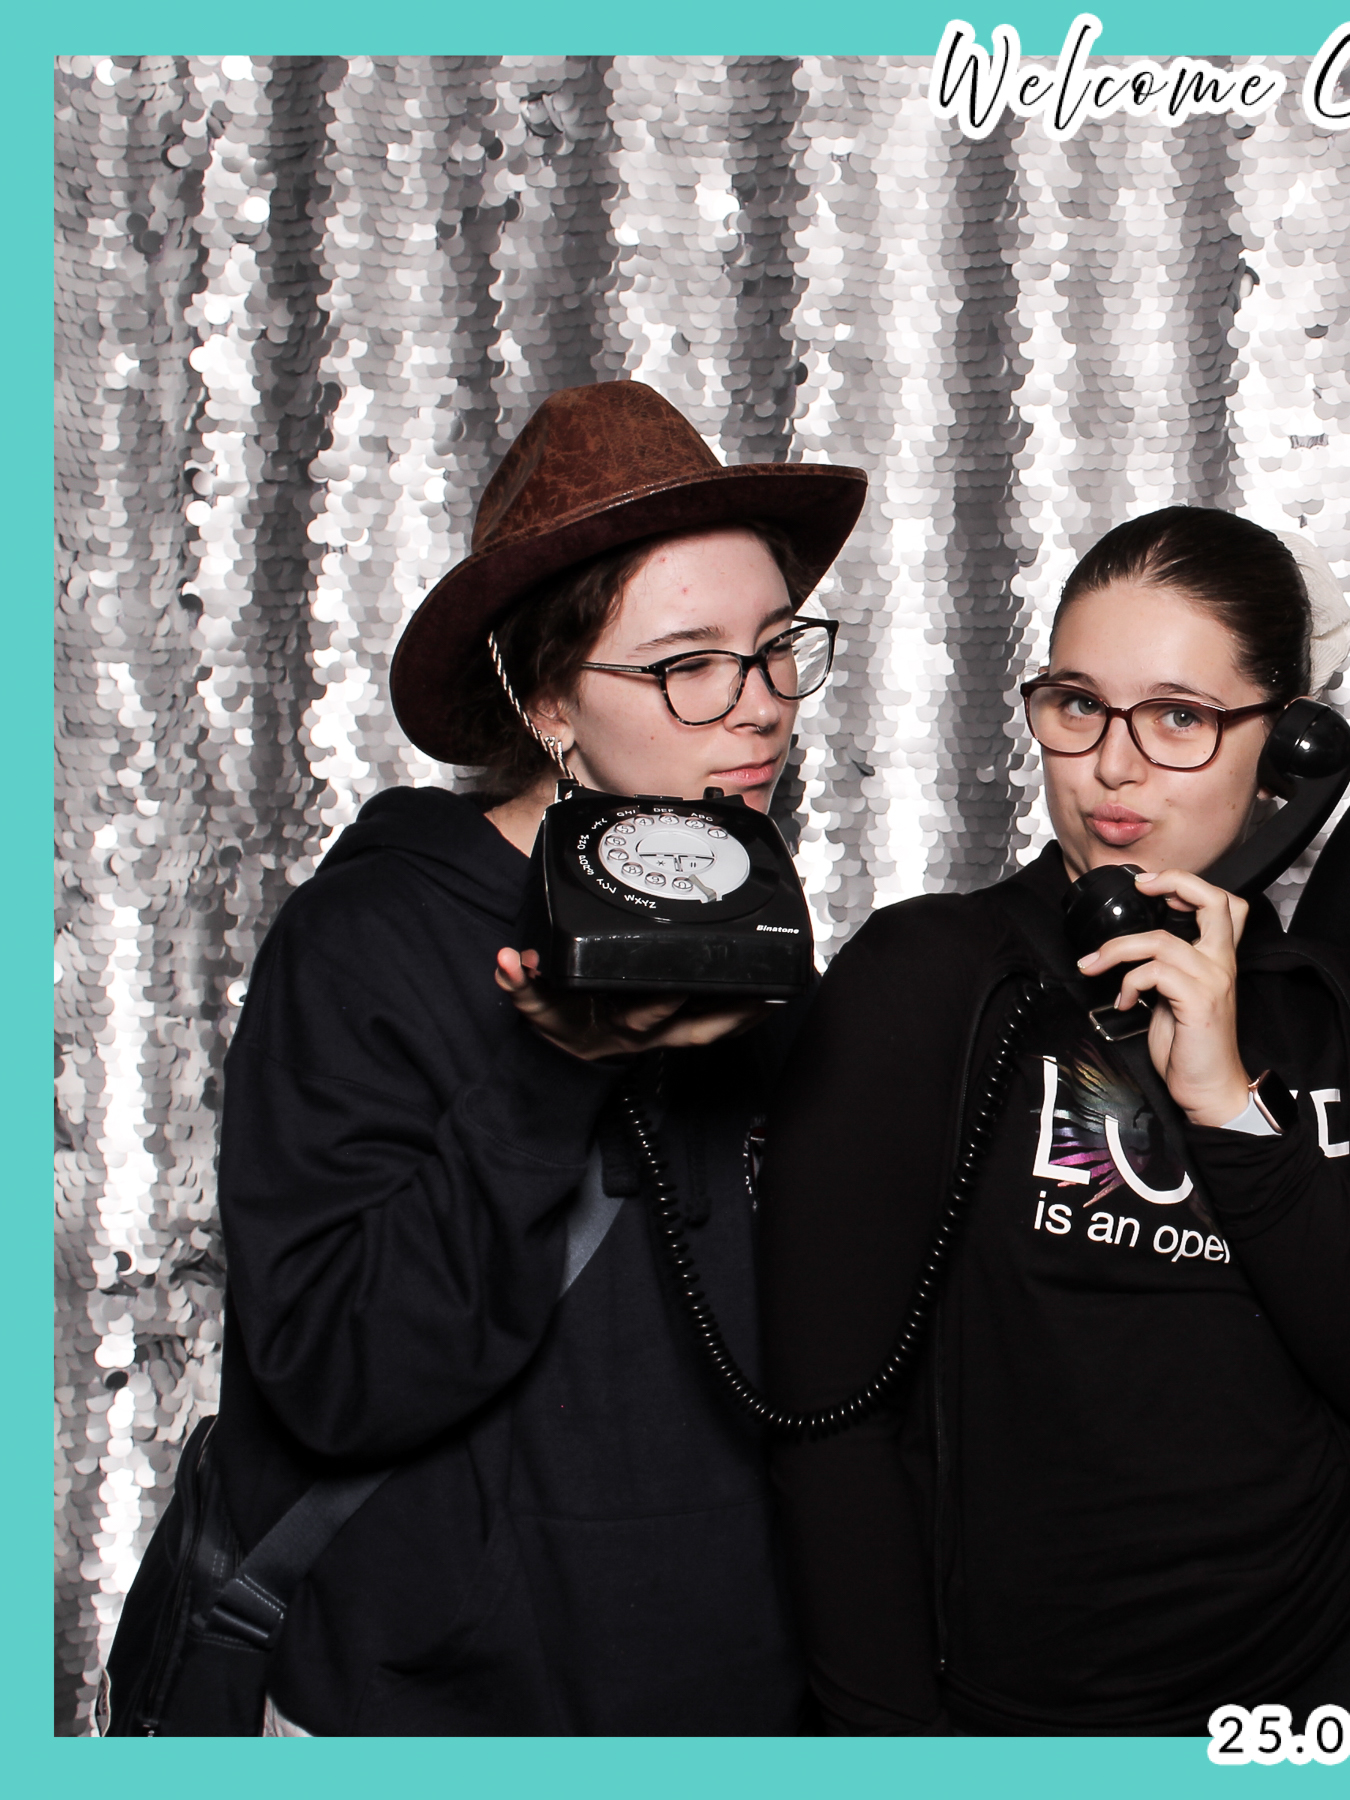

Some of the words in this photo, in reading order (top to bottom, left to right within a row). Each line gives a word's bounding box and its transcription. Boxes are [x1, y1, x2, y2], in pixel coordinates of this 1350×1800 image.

[616, 809, 636, 817] GHI
[577, 834, 589, 850] MNO
[596, 878, 617, 894] TUV
[624, 894, 657, 909] WXYZ
[756, 924, 800, 934] Binatone
[1034, 1191, 1072, 1235] is
[1087, 1211, 1140, 1247] an
